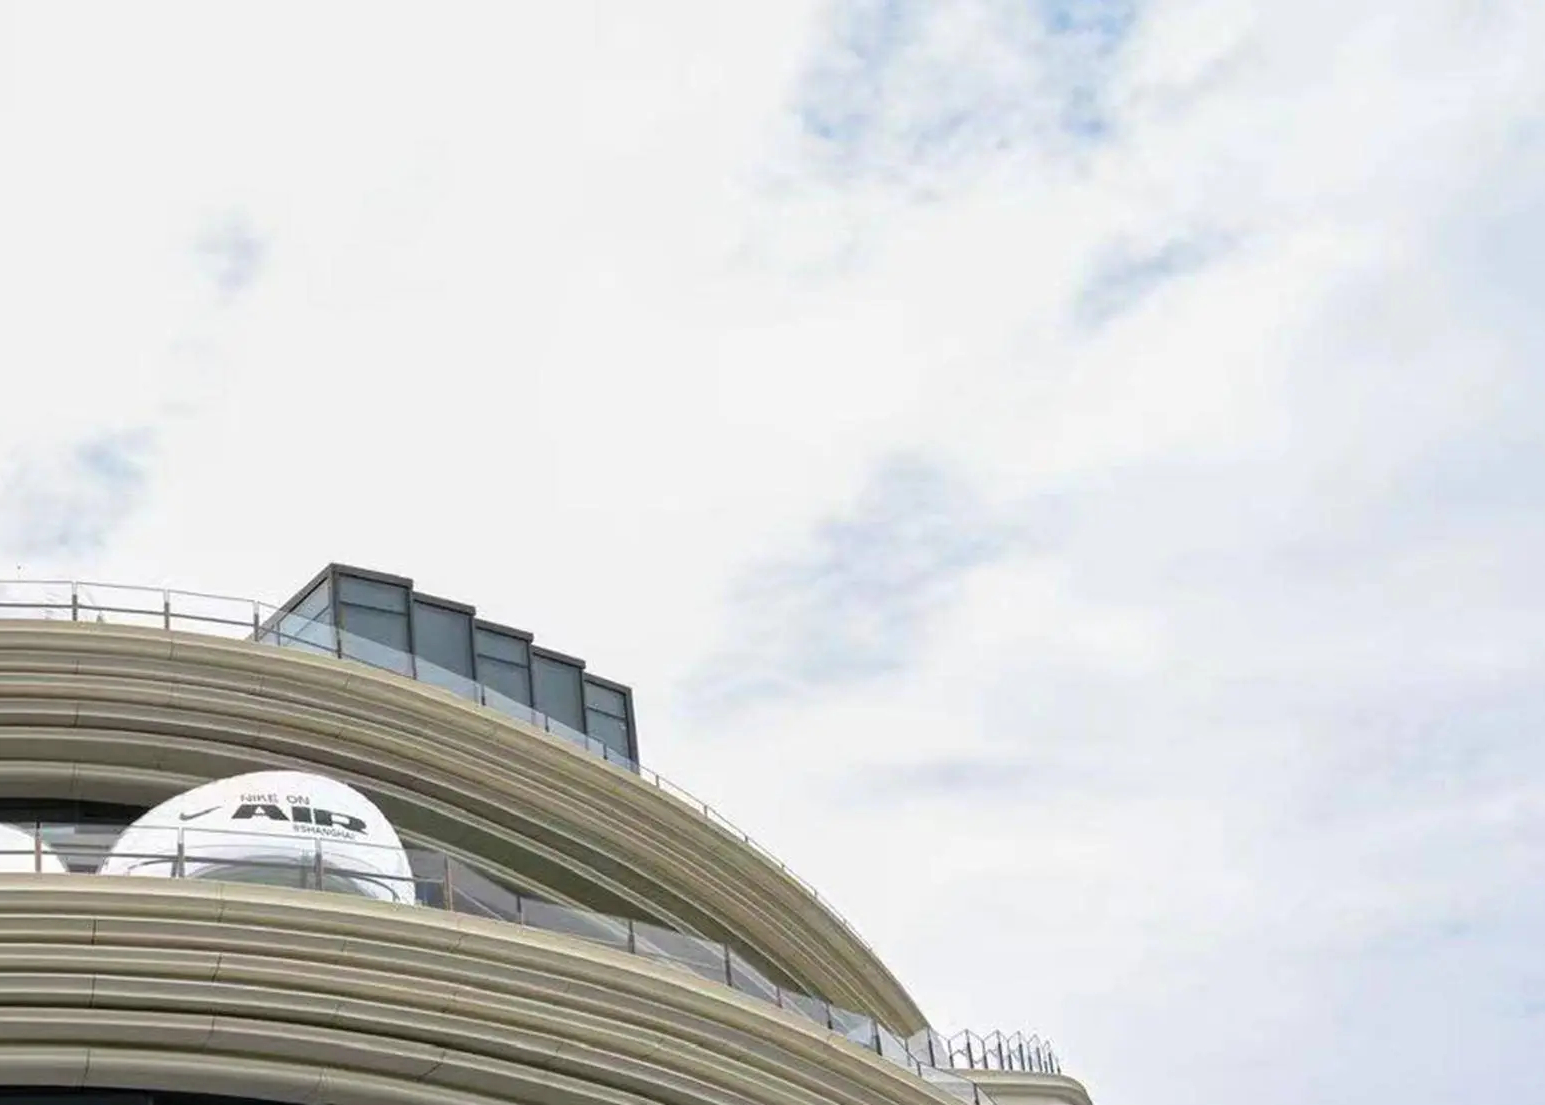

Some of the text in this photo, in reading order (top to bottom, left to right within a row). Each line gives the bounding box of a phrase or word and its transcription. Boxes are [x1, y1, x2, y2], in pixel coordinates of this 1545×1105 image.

[239, 792, 311, 806] NIKE ON
[231, 803, 369, 836] AIR
